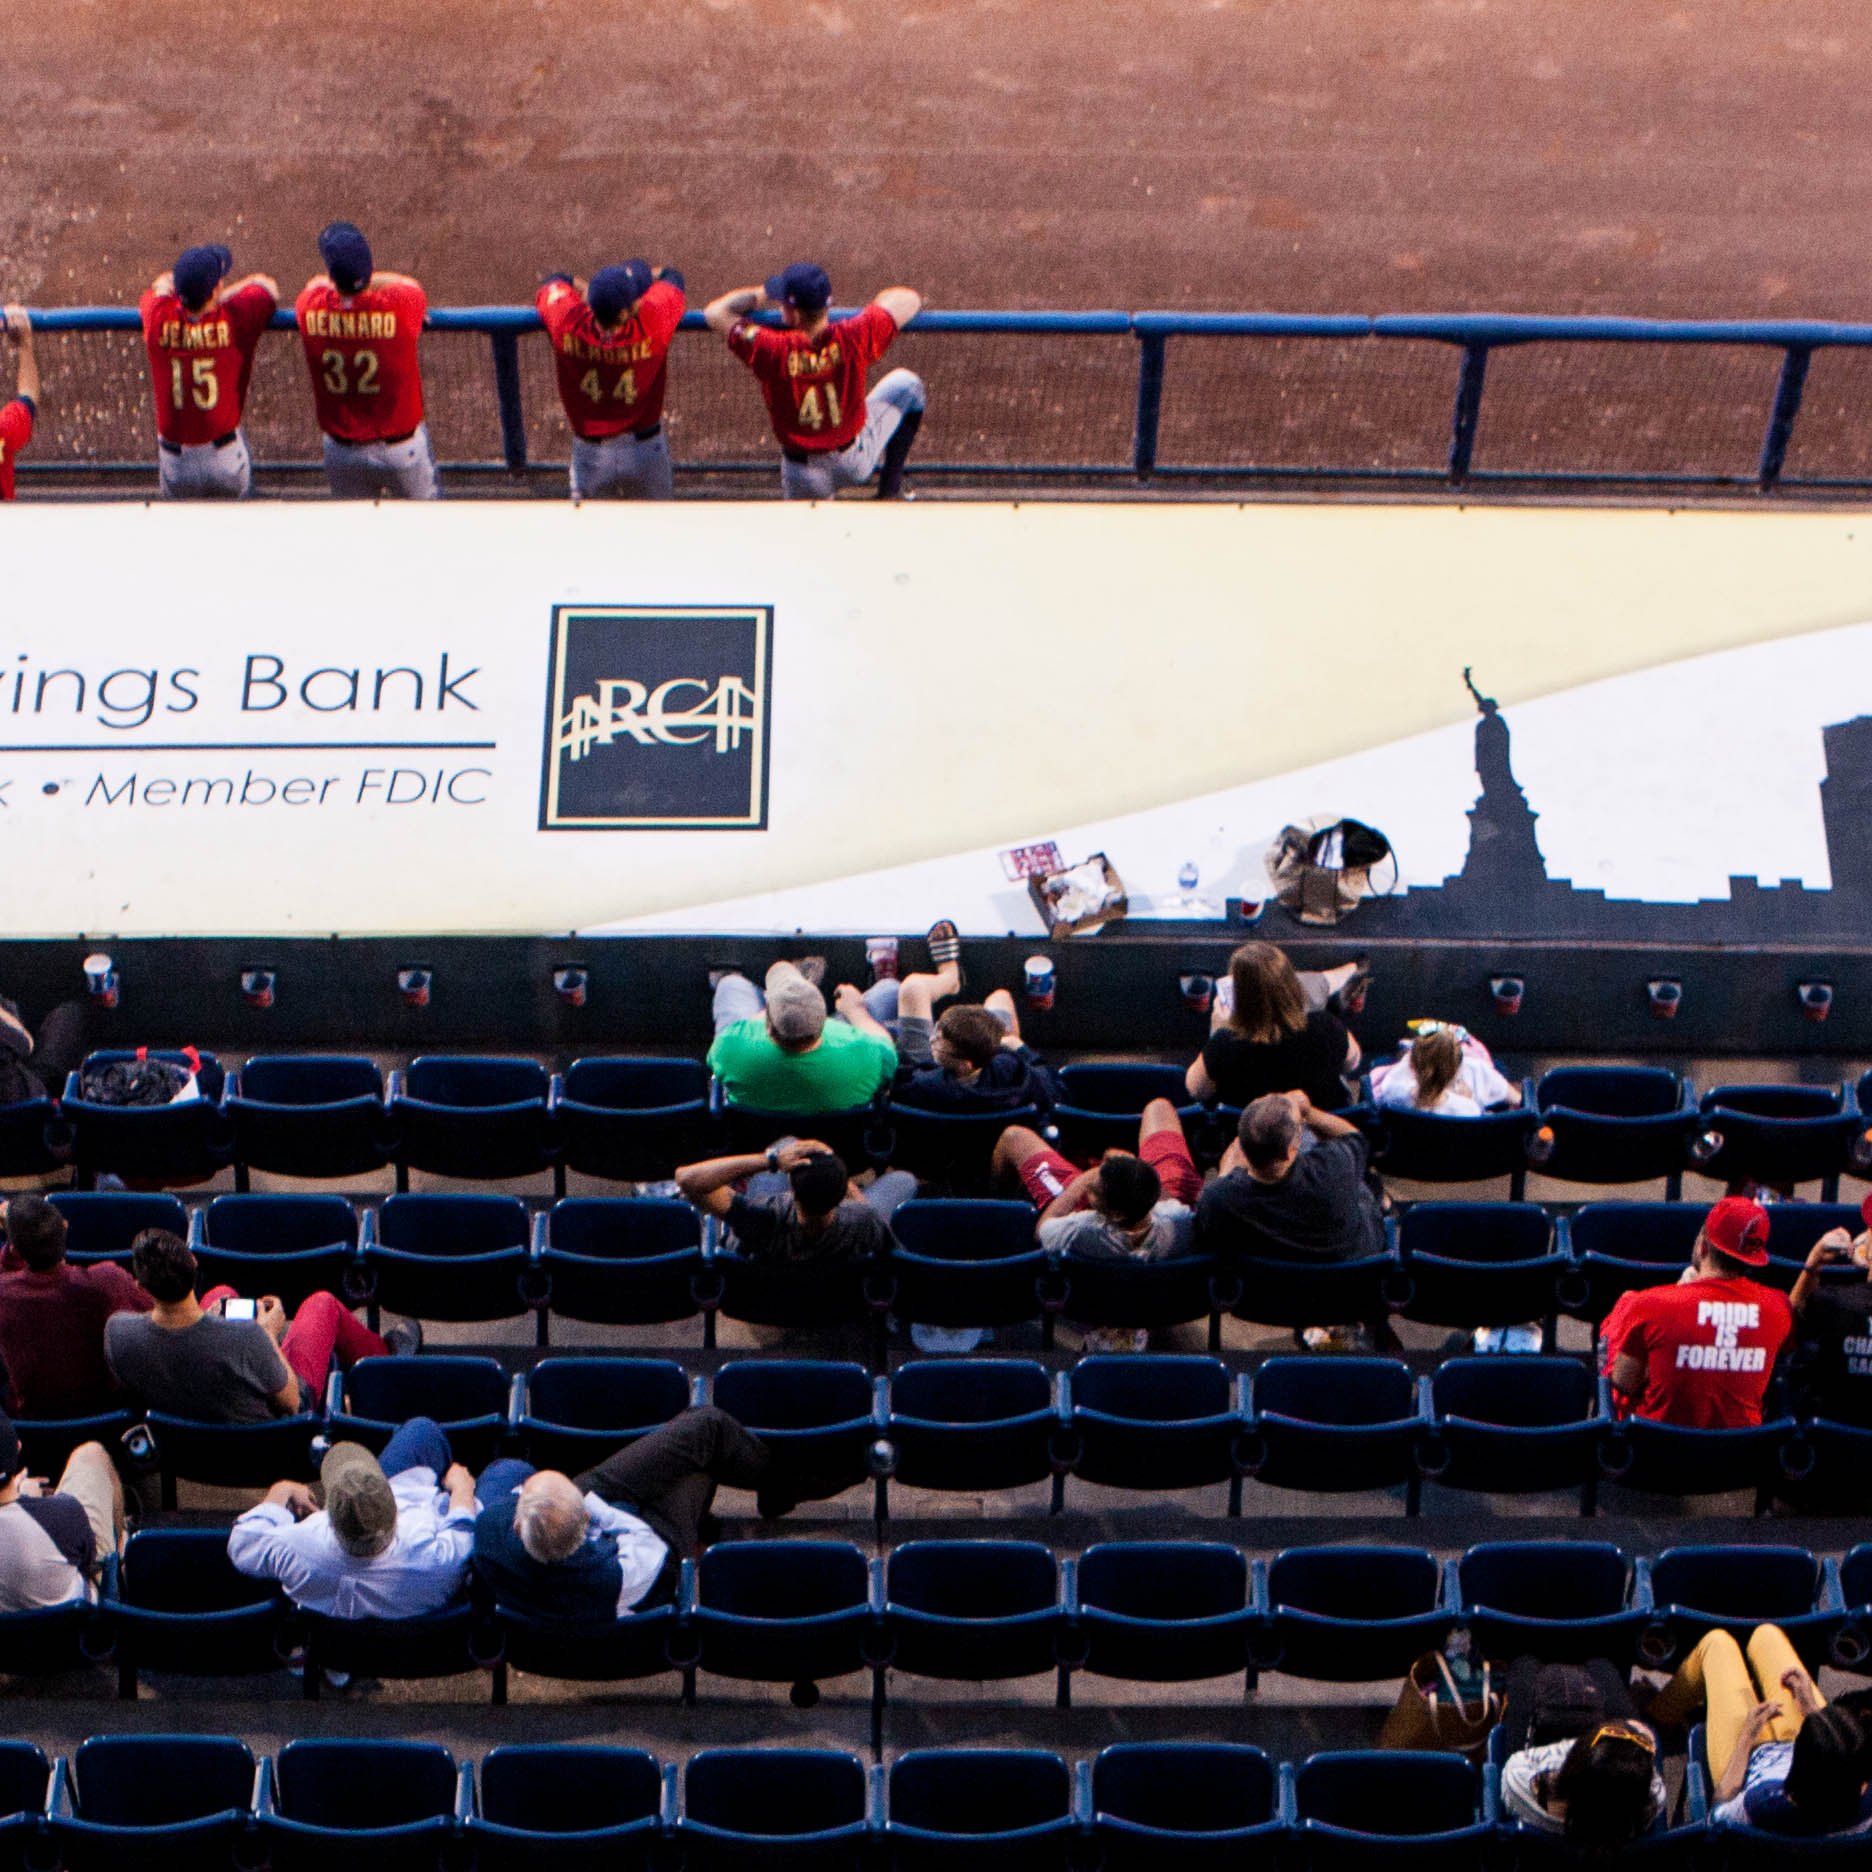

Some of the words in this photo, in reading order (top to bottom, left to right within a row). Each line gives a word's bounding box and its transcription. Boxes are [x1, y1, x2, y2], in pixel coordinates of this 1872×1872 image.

[171, 357, 219, 411] 15
[321, 349, 381, 395] 32
[580, 366, 638, 404] 44
[799, 381, 842, 430] 41
[239, 652, 483, 712] Bank
[83, 767, 340, 809] Member
[355, 766, 492, 806] FDIC
[1697, 1300, 1761, 1329] PRIDE
[1714, 1324, 1740, 1348] IS
[1675, 1345, 1767, 1372] FOREVER
